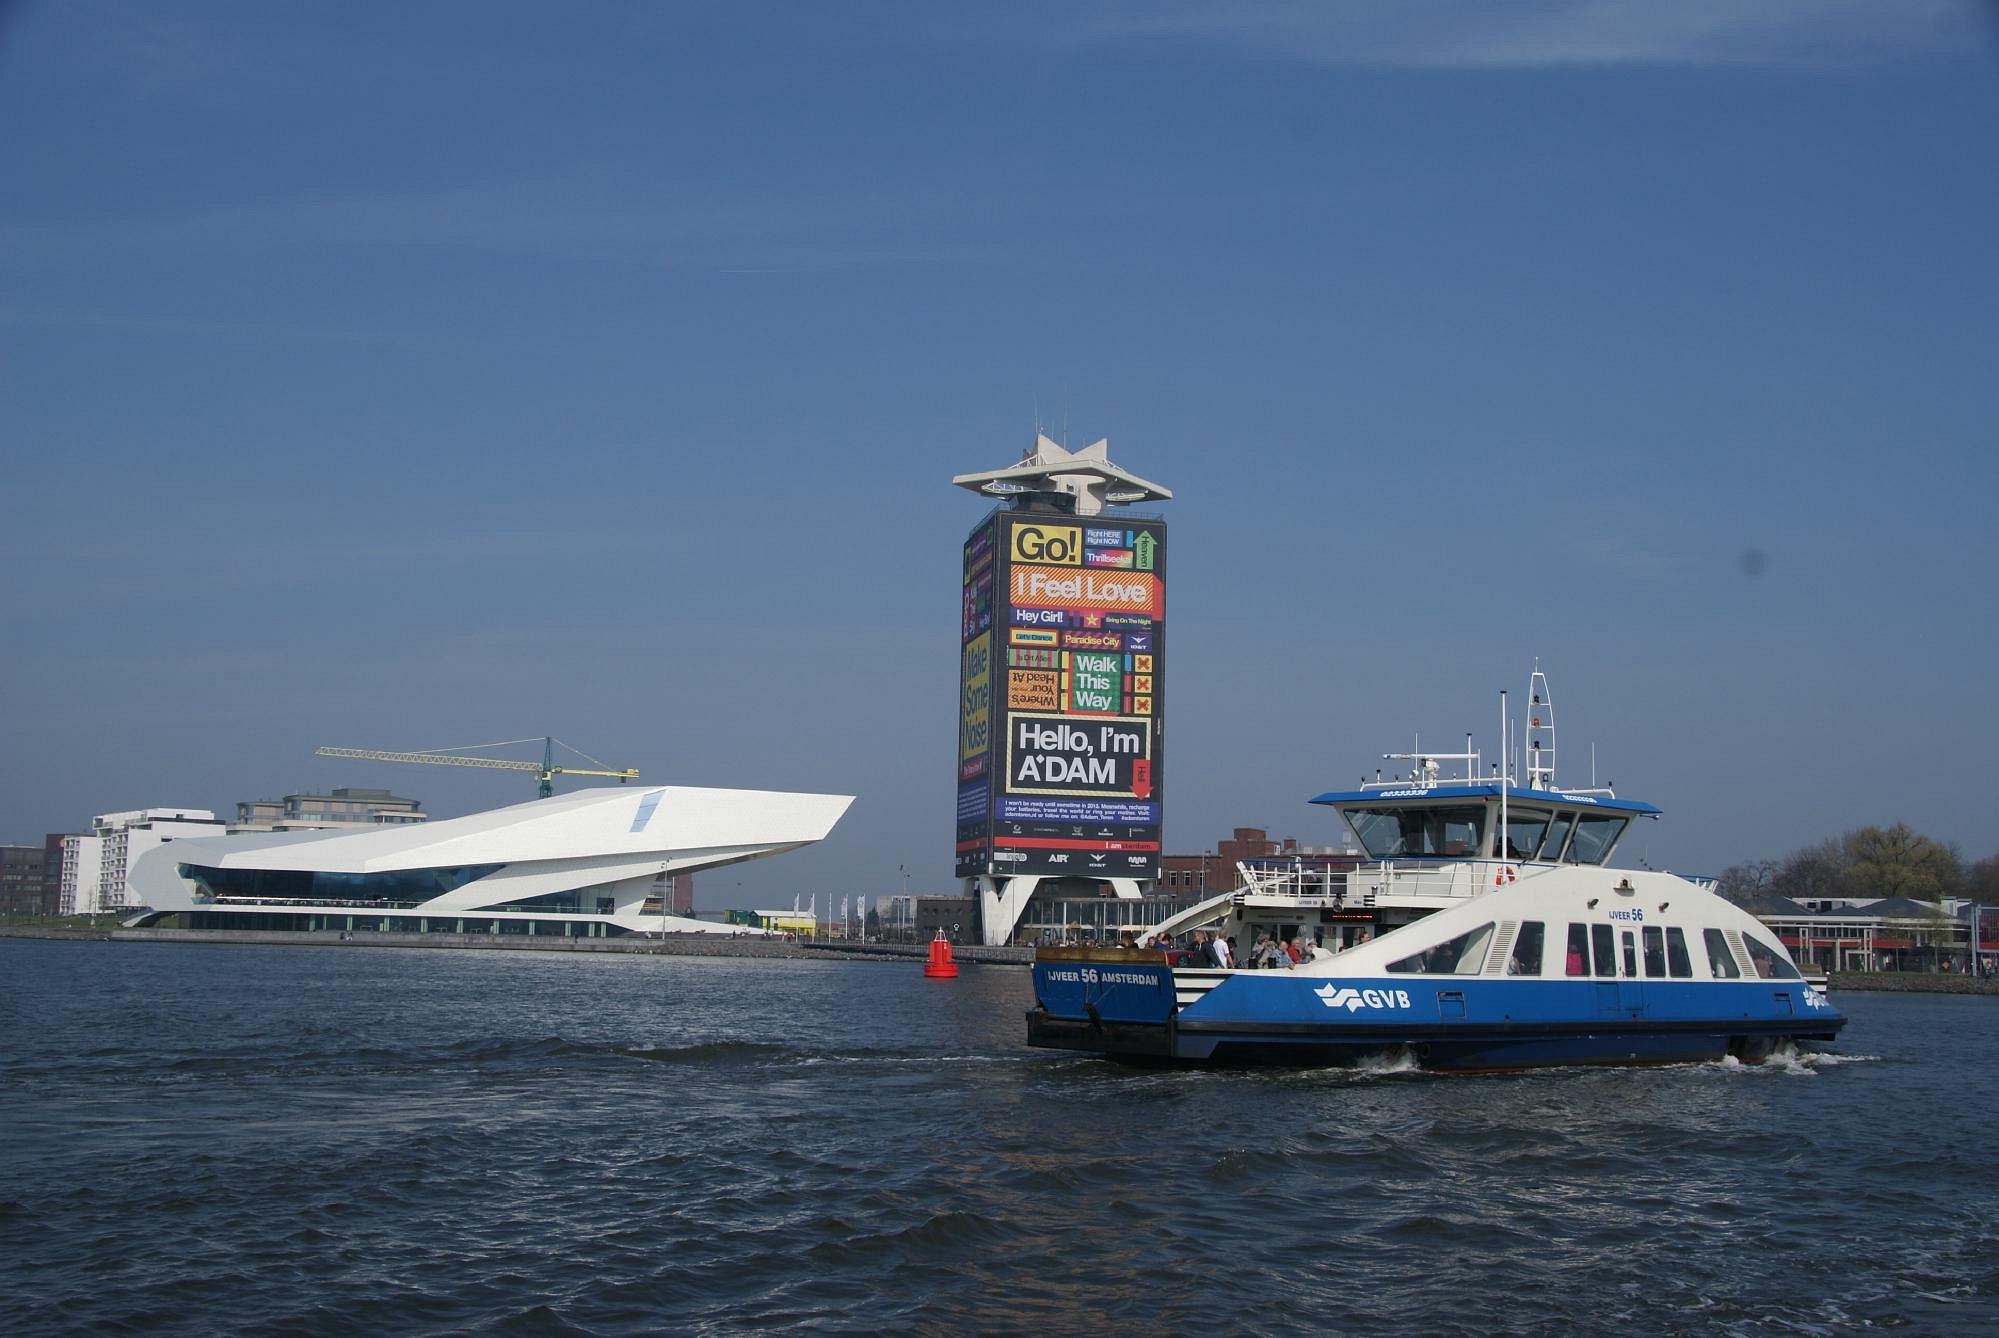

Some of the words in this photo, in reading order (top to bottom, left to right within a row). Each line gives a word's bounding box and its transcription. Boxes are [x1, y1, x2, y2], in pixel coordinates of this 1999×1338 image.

[1088, 529, 1103, 538] Right
[1104, 530, 1121, 538] HERE
[1088, 537, 1103, 545] Right
[1016, 527, 1077, 562] Go!
[1141, 536, 1150, 568] Heaven
[1017, 572, 1024, 596] I
[1030, 573, 1081, 601] Feel
[1087, 575, 1147, 603] Love
[1016, 609, 1039, 623] Hey
[1040, 610, 1064, 623] Girl!
[1065, 634, 1102, 646] Paradise
[1102, 636, 1120, 648] City
[968, 645, 987, 681] Make
[1076, 655, 1117, 673] Walk
[1012, 672, 1024, 683] At
[1026, 673, 1055, 684] Head
[1077, 673, 1110, 690] This
[966, 682, 988, 717] Some
[1011, 694, 1055, 706] Where's
[1076, 691, 1112, 711] Way
[966, 716, 987, 750] Noise
[1019, 722, 1094, 757] Hello,
[1100, 726, 1139, 754] I'm
[1048, 854, 1068, 863] AIR
[1608, 910, 1631, 920] IJVEER
[1632, 908, 1644, 921] 56
[1047, 970, 1080, 983] IJVEER
[1081, 968, 1098, 984] 56
[1101, 972, 1160, 987] AMSTERDAM
[1362, 989, 1411, 1009] GVB
